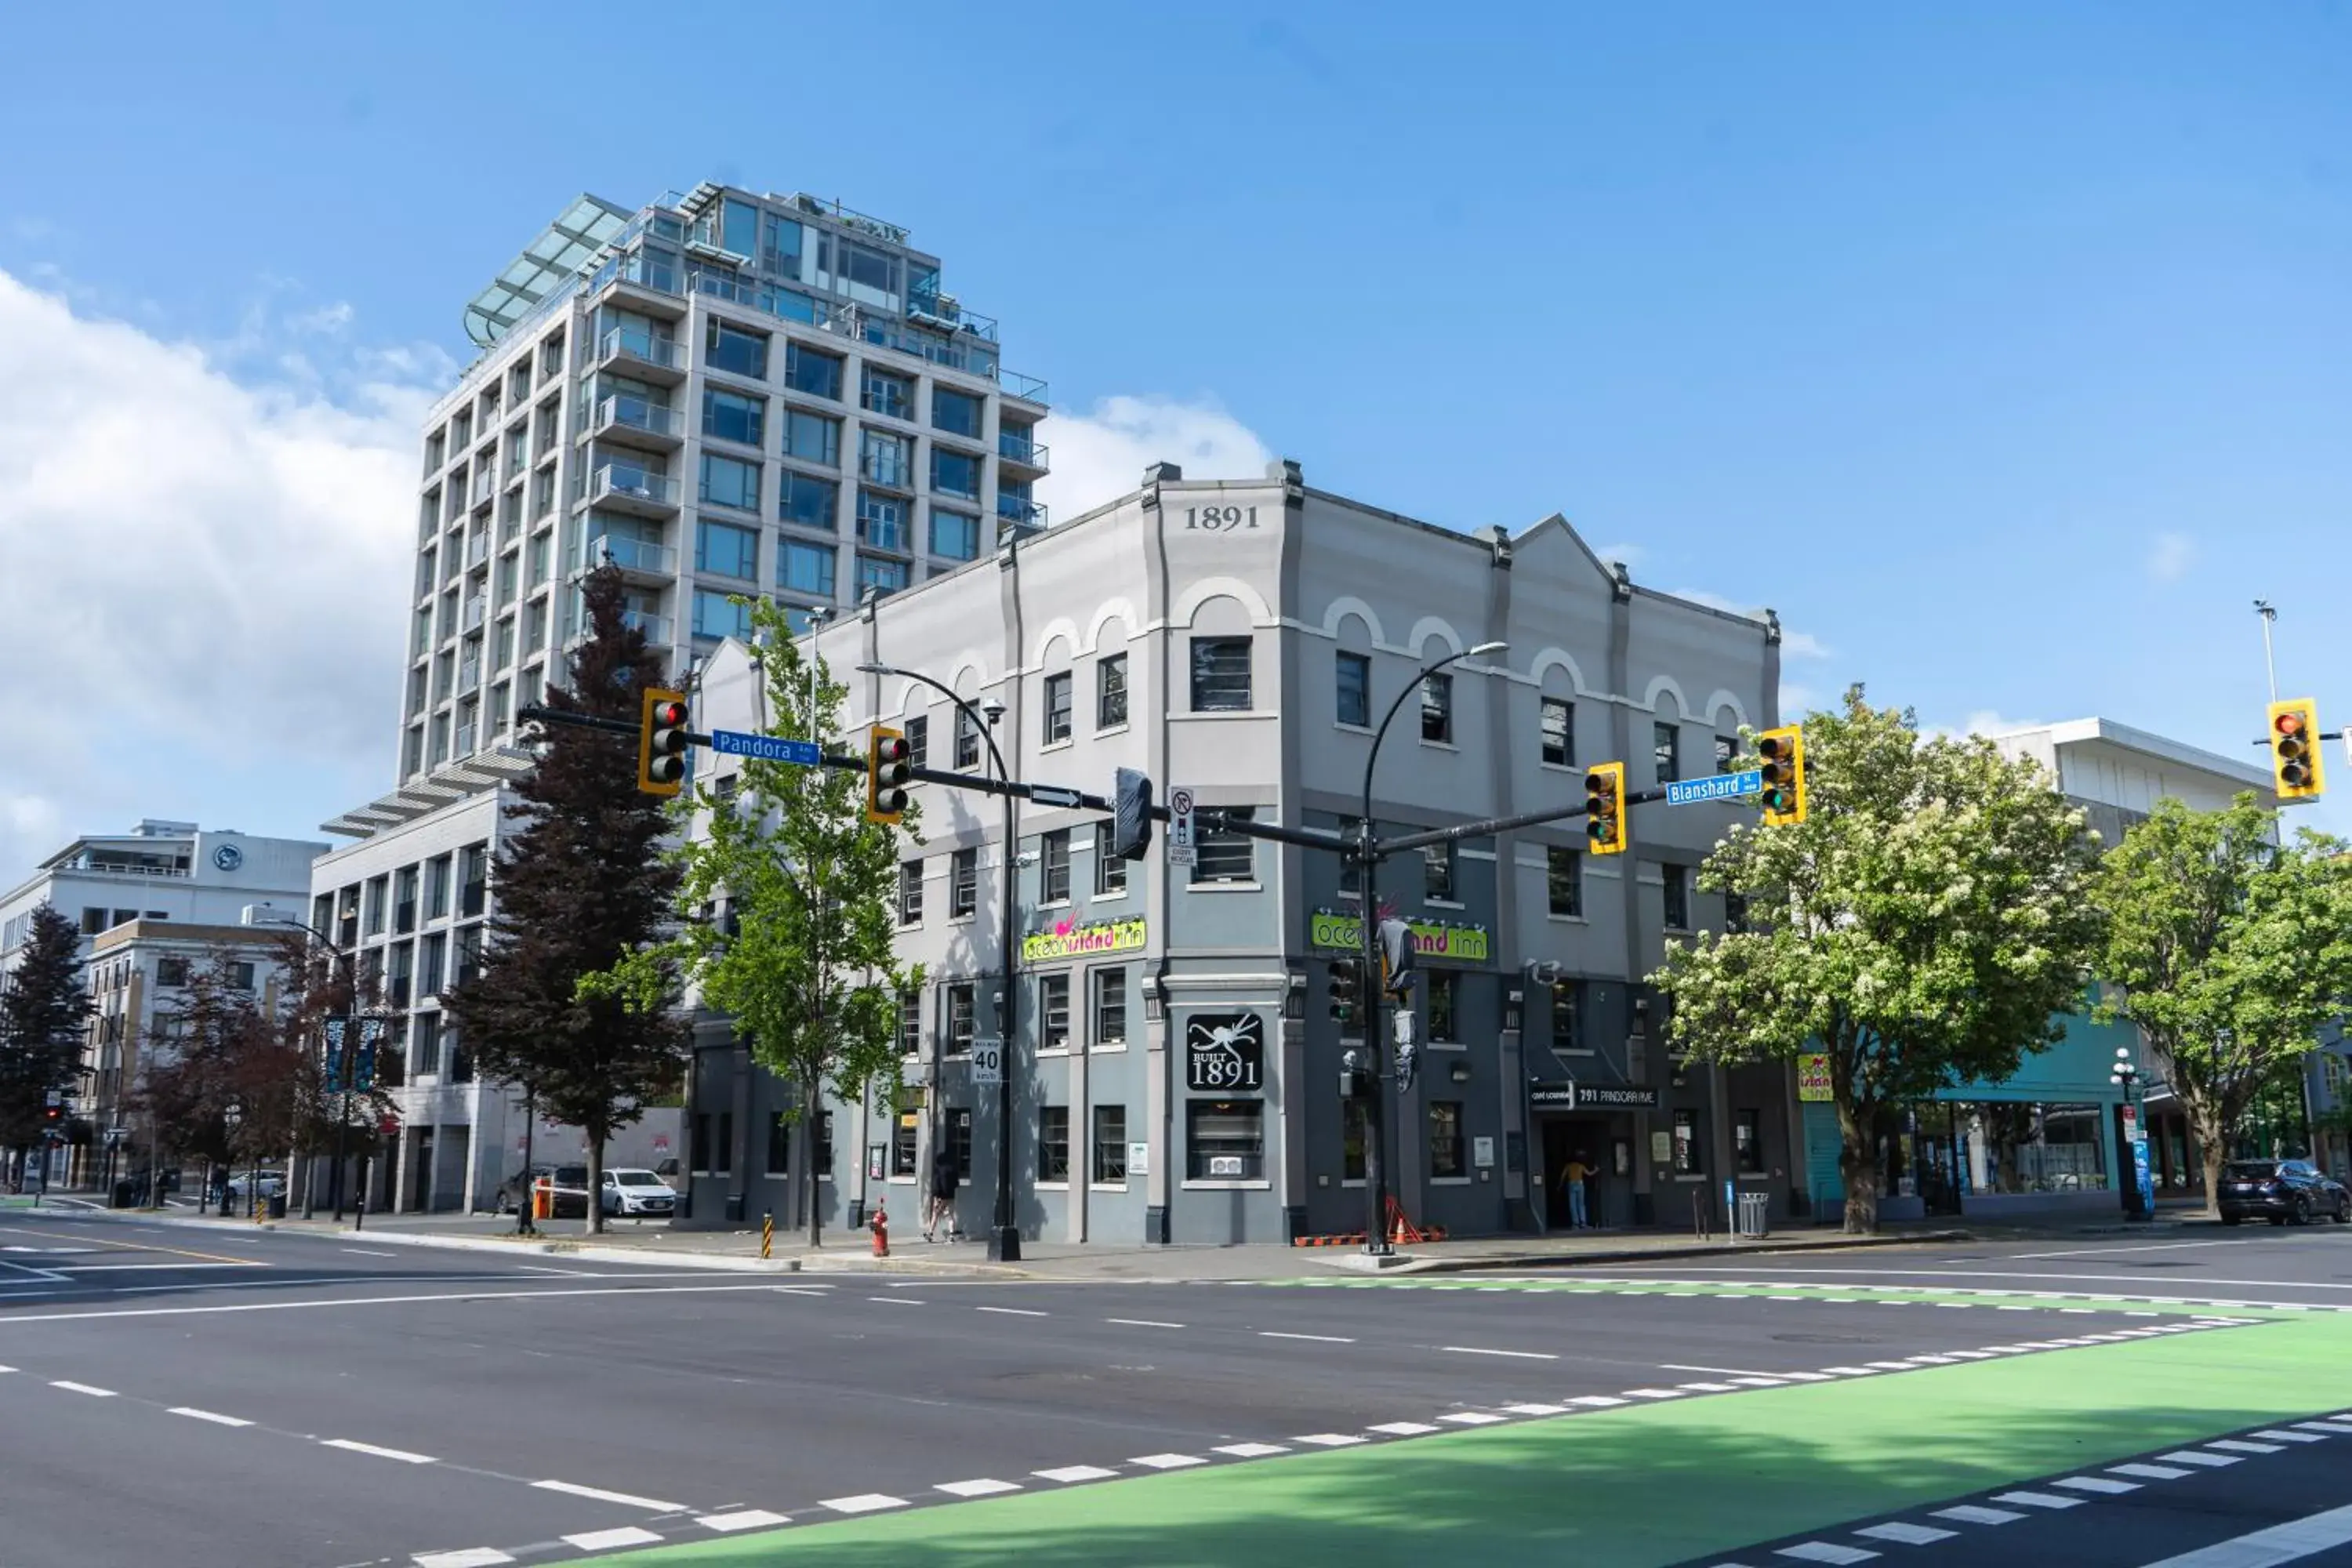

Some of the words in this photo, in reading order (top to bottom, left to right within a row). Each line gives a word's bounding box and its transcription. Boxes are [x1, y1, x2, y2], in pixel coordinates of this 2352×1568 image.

[1184, 506, 1260, 532] 1891
[720, 735, 791, 759] Pandora
[1671, 775, 1739, 801] Blanshard
[1456, 932, 1484, 956] inn
[975, 1051, 998, 1069] 40
[1192, 1053, 1227, 1062] BUILT
[1192, 1061, 1258, 1087] 1891
[1580, 1089, 1597, 1102] 791
